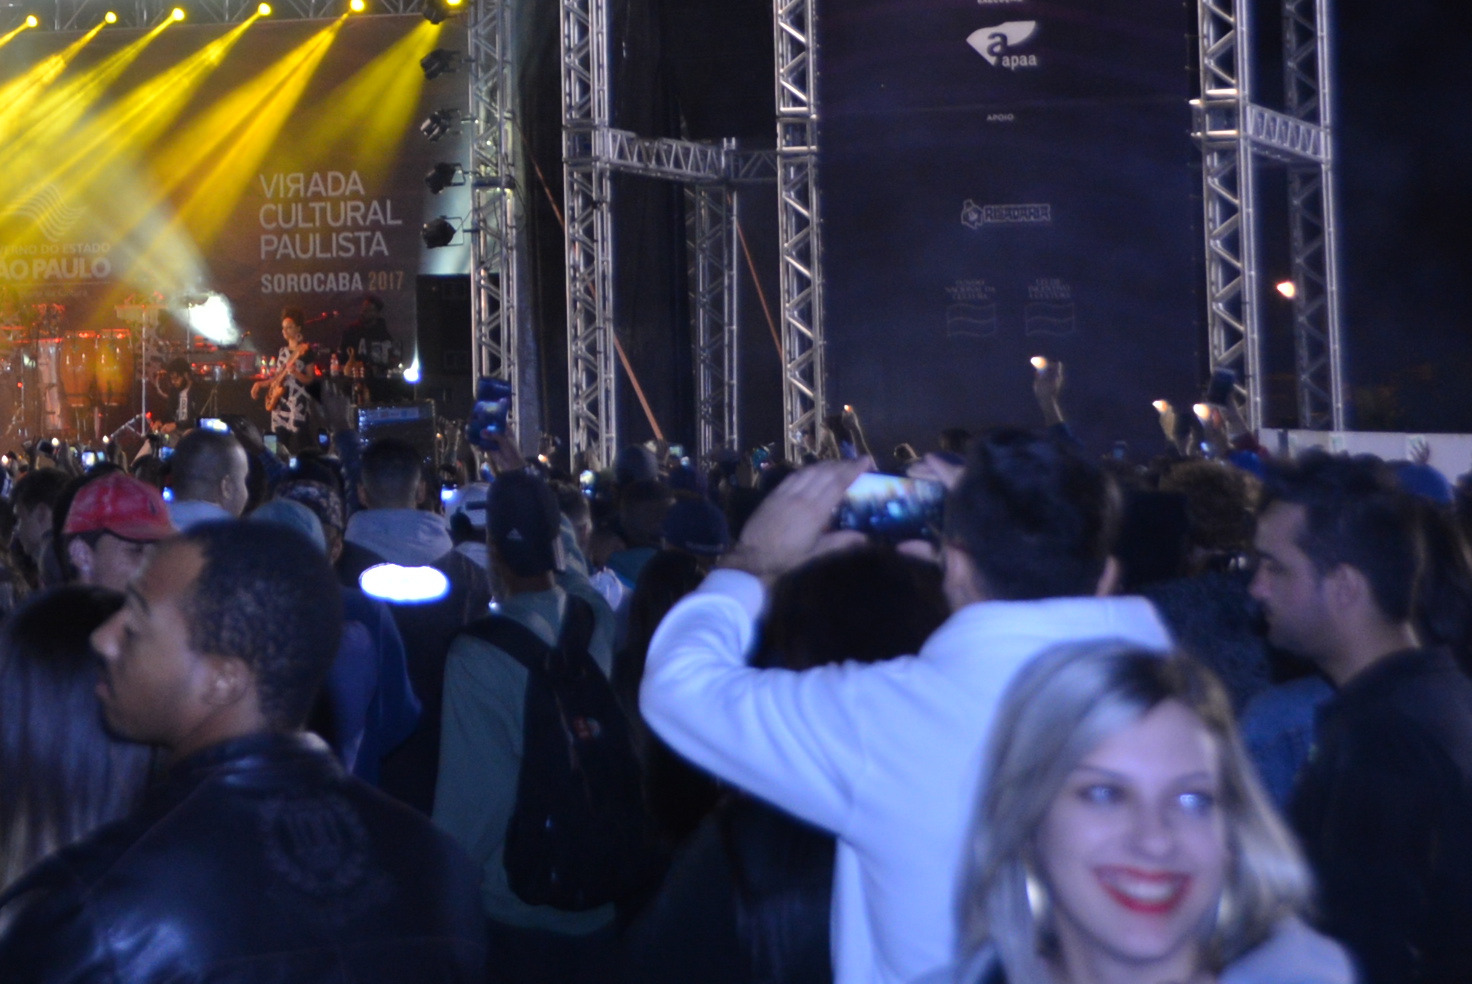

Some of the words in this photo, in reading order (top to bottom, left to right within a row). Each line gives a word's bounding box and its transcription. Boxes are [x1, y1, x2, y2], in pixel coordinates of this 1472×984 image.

[1002, 54, 1038, 70] apaa
[258, 199, 402, 230] CULTURAL
[40, 244, 59, 254] DO
[62, 242, 111, 254] ESTADO
[260, 231, 390, 261] PAULISTA
[32, 256, 112, 279] PAULO
[260, 272, 362, 294] SOROCABA
[368, 270, 405, 292] 2017
